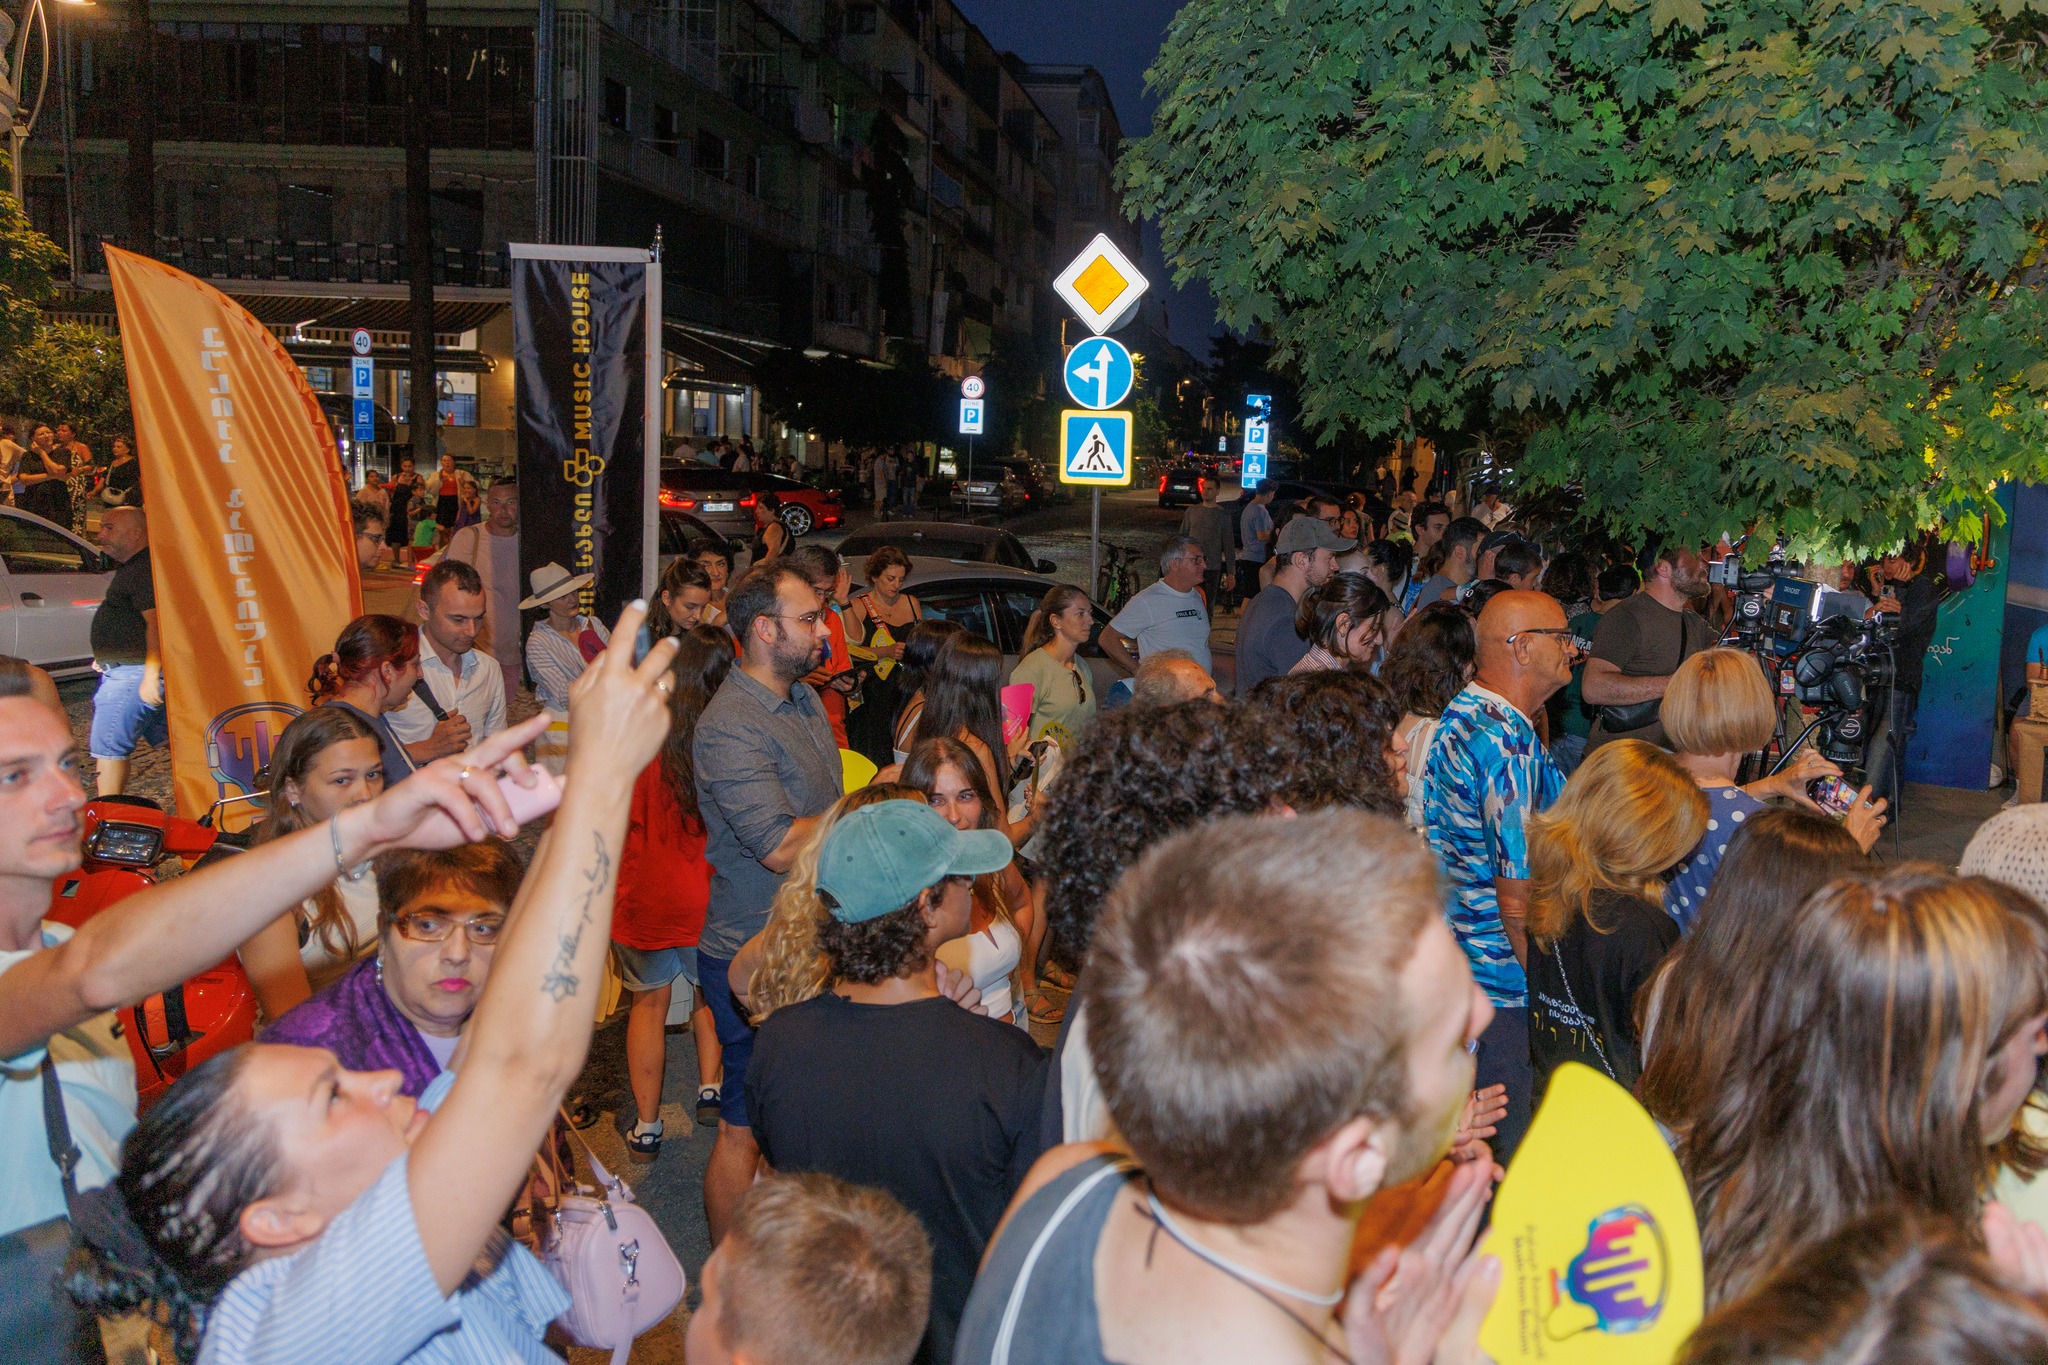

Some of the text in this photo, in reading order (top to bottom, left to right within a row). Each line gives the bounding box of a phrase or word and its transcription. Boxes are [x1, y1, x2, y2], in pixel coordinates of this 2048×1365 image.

[356, 336, 368, 347] 40
[571, 272, 593, 440] MUSIC HOUSE
[358, 370, 367, 385] P
[966, 383, 980, 392] 40
[967, 410, 976, 422] P
[1251, 429, 1261, 442] P
